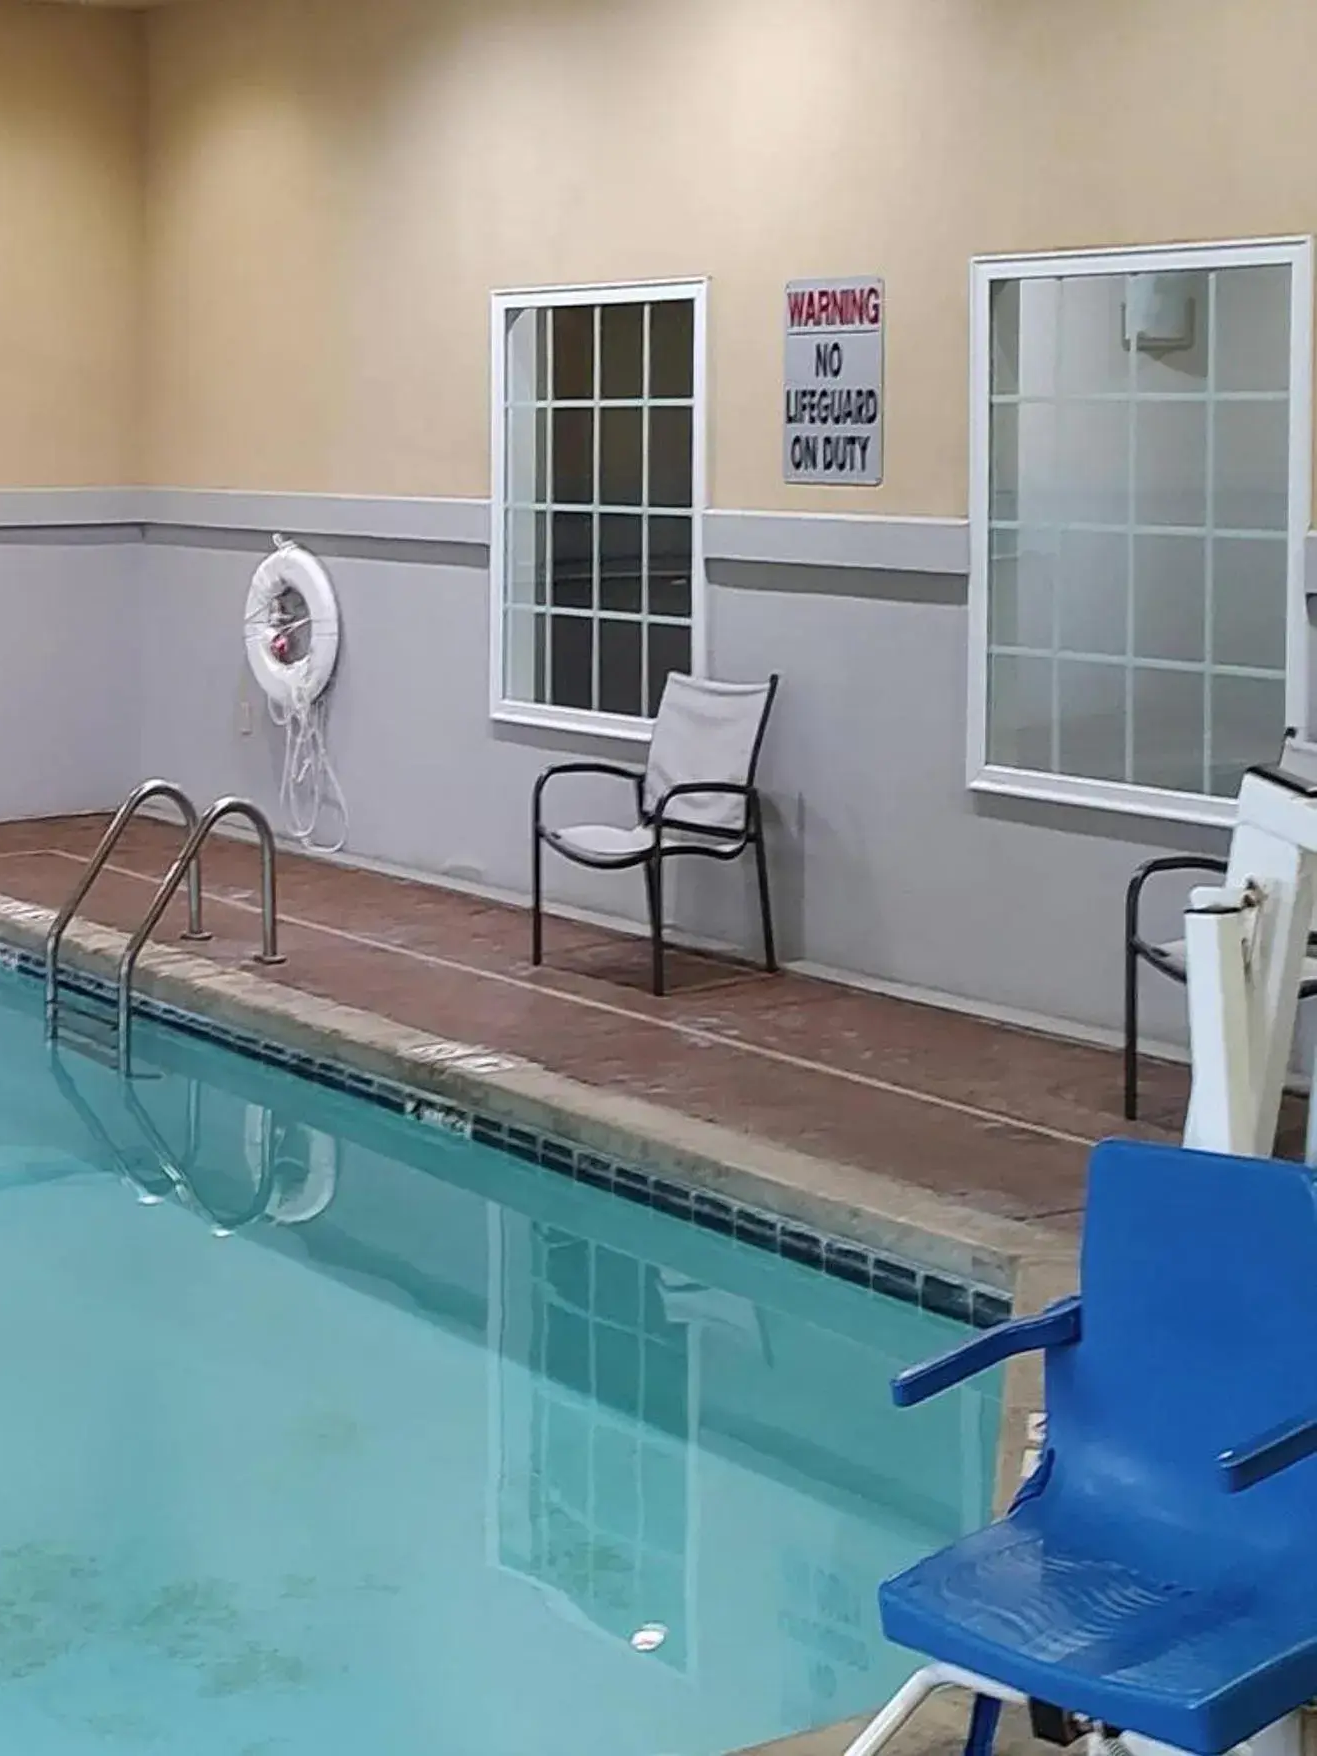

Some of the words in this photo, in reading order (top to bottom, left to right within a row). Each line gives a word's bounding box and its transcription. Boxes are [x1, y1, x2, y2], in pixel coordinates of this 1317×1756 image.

[787, 288, 880, 327] WARNING
[815, 342, 842, 378] NO
[785, 389, 878, 424] LIFEGUARD
[790, 436, 819, 470] ON
[823, 436, 871, 471] DUTY
